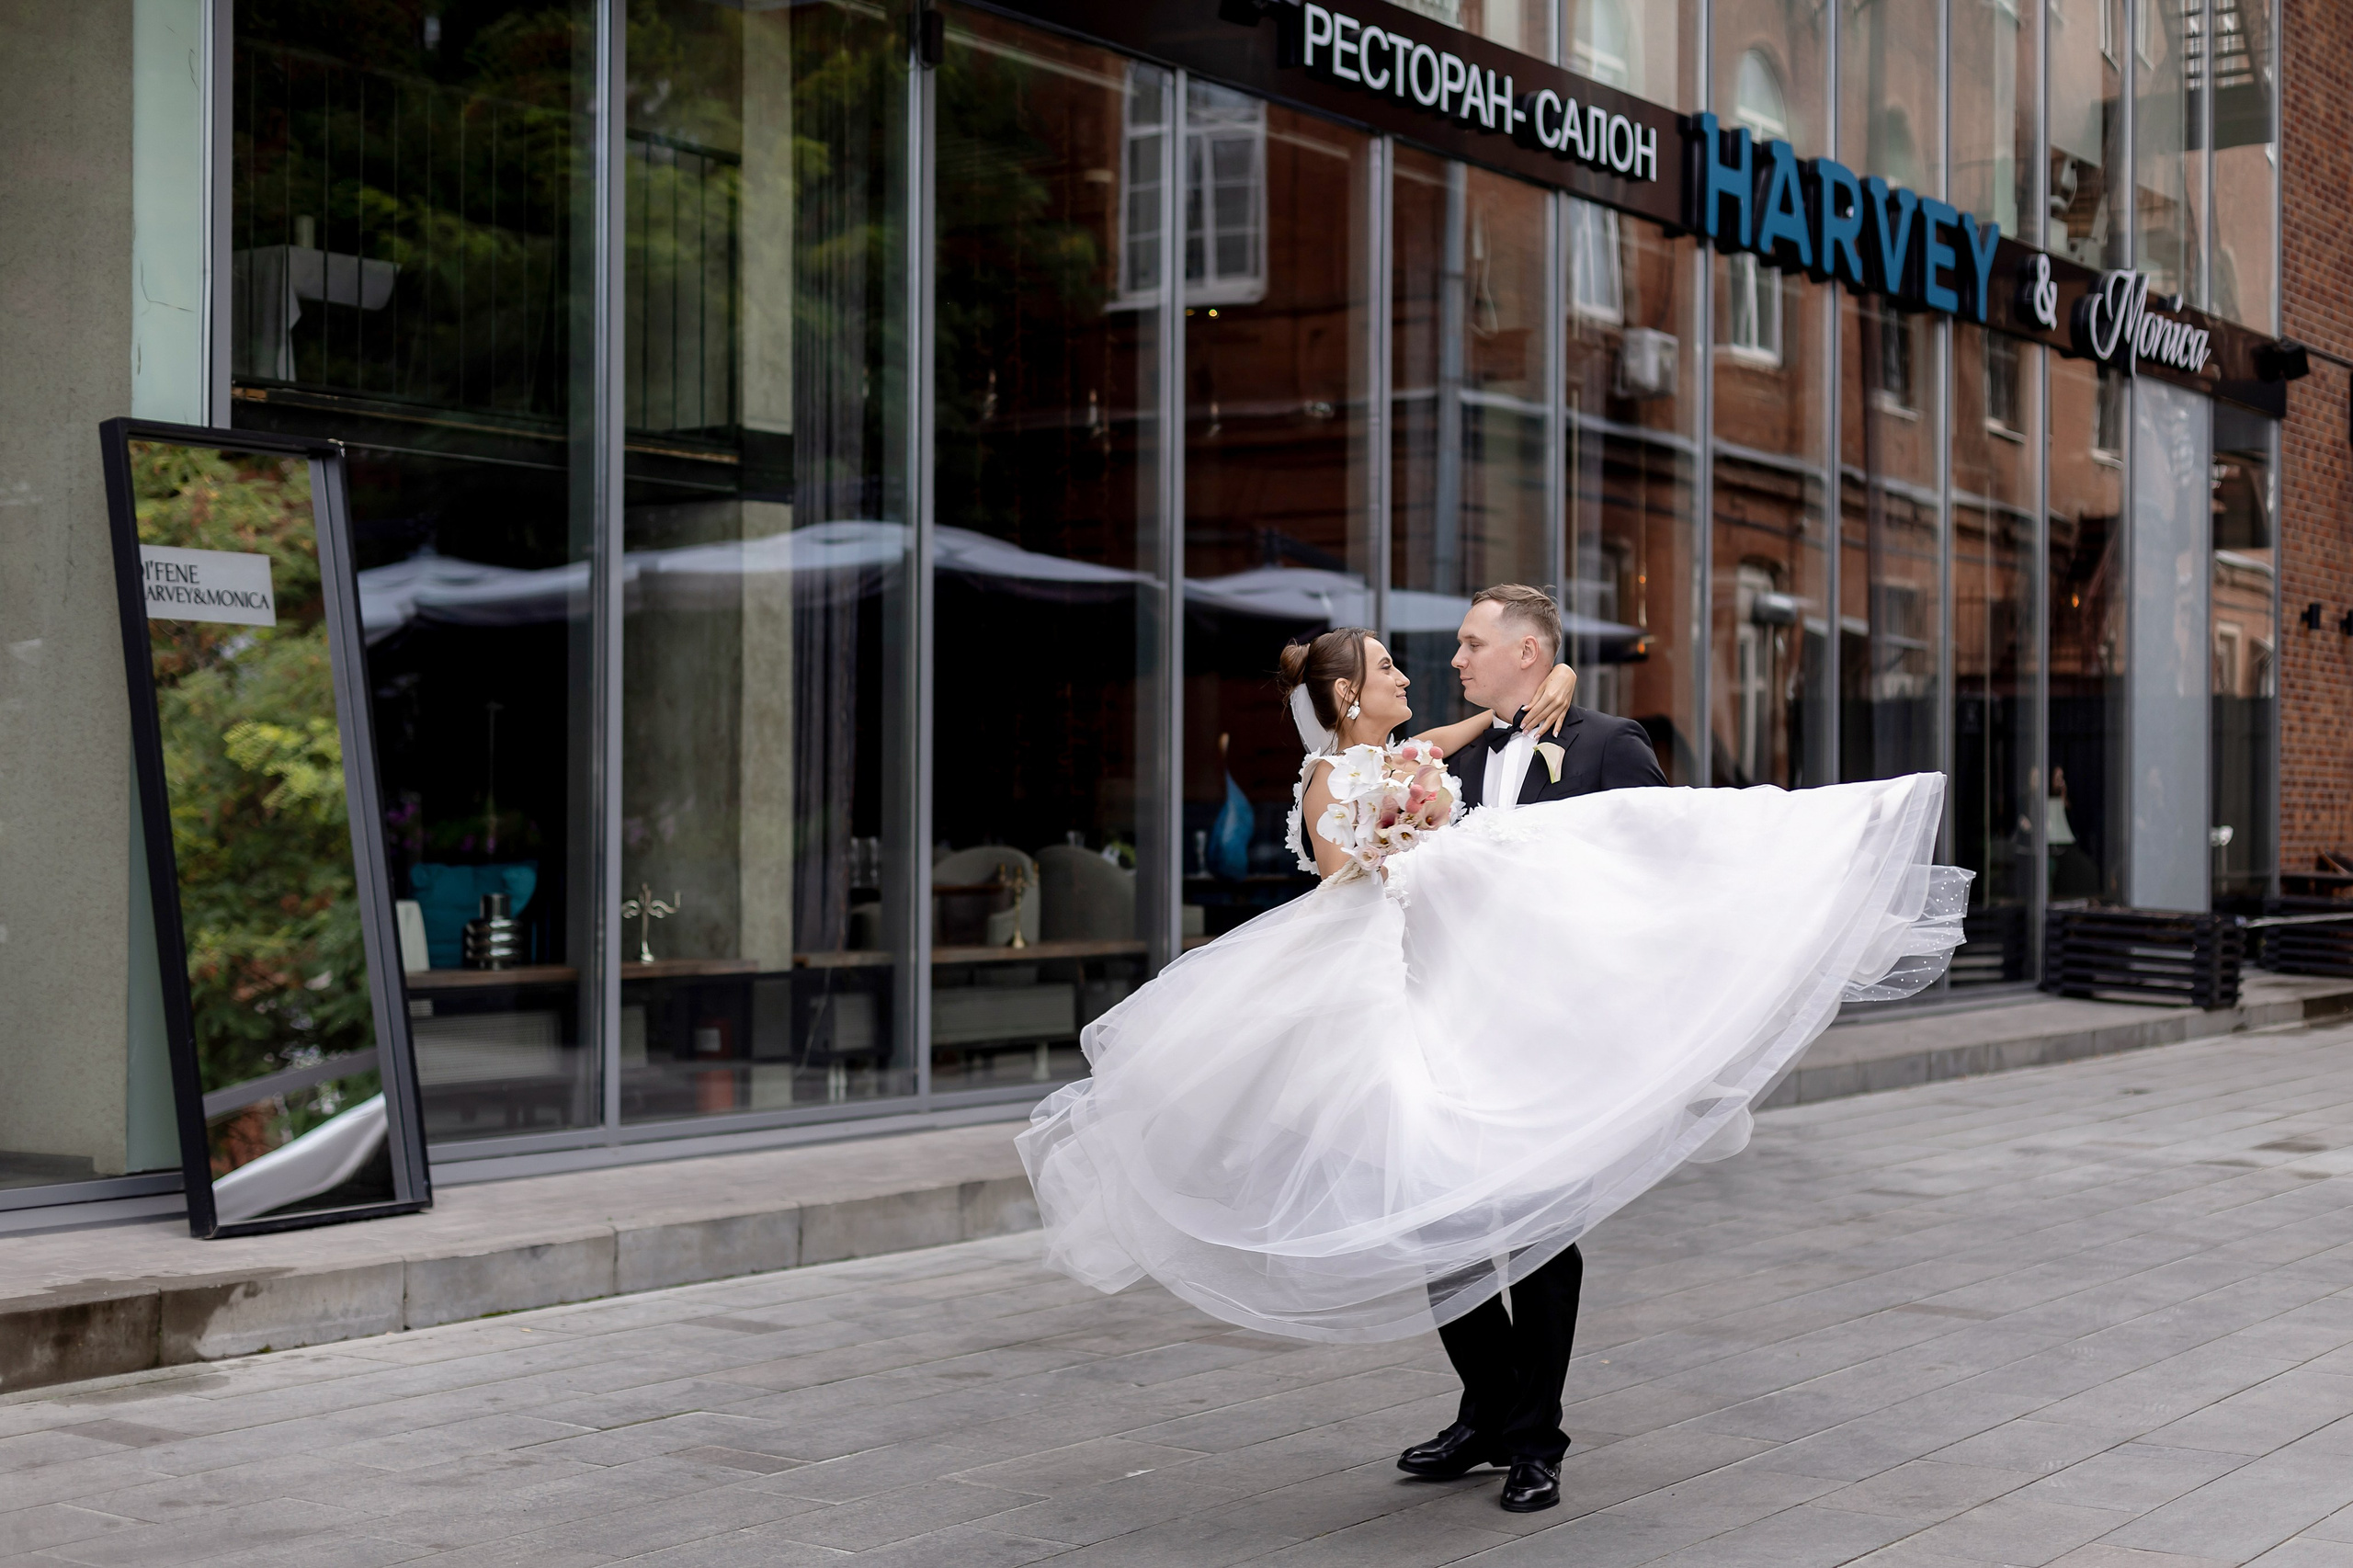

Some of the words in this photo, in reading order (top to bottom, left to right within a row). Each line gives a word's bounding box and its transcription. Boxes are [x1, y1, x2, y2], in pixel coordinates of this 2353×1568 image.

[1303, 2, 1527, 135] РЕСТОРАН-
[1534, 88, 1657, 182] САЛОН
[1700, 111, 2001, 324] HARVEY
[2032, 252, 2058, 332] &
[2088, 267, 2212, 380] Monica
[141, 560, 200, 585] I'FENE
[144, 585, 270, 610] ARVEY&MONICA
